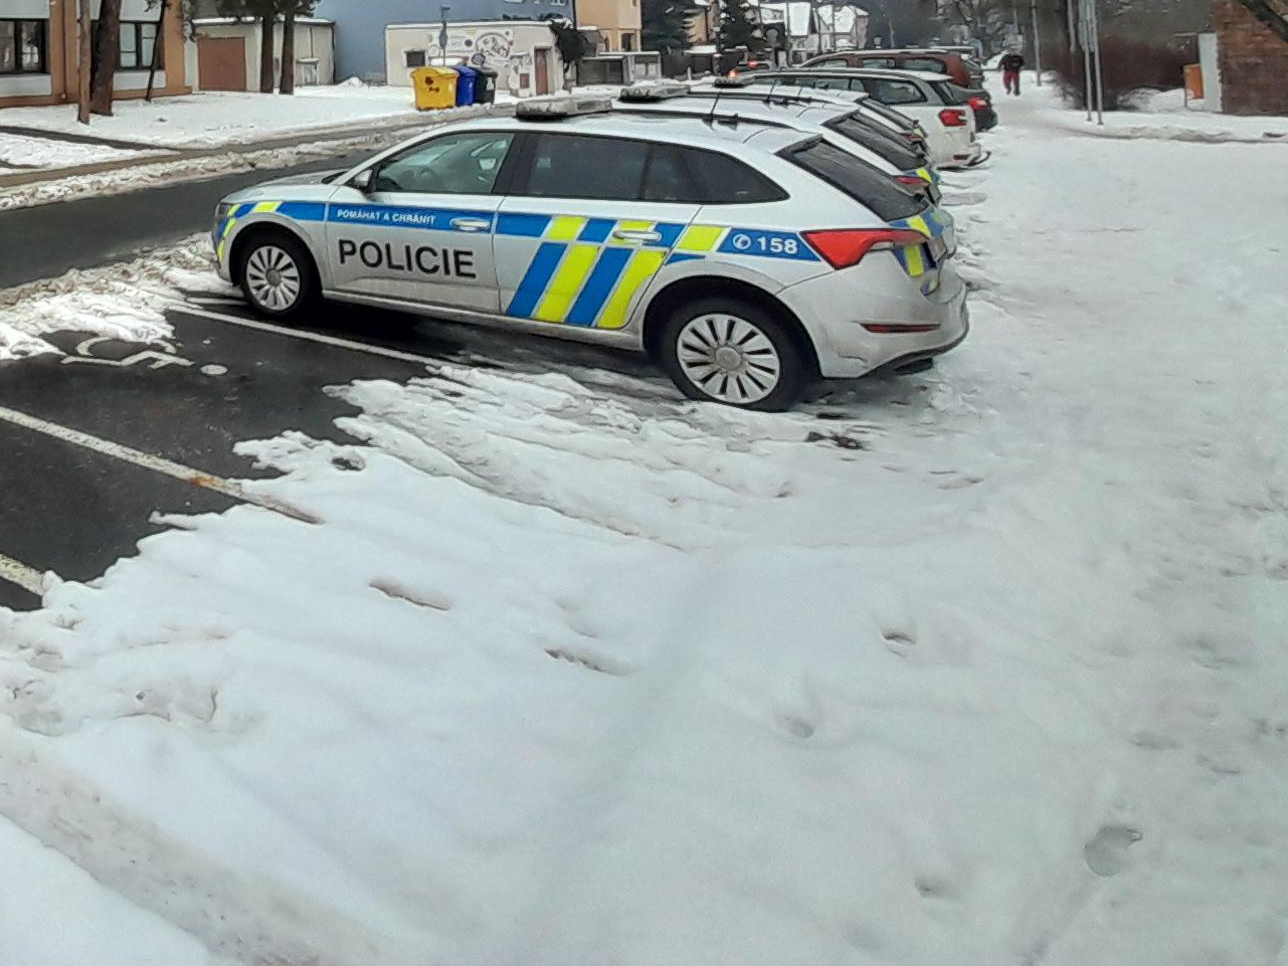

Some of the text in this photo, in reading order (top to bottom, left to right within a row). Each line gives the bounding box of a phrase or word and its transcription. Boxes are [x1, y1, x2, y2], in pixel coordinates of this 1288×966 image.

[383, 212, 390, 222] A
[757, 236, 798, 255] 158
[338, 238, 477, 279] POLICIE
